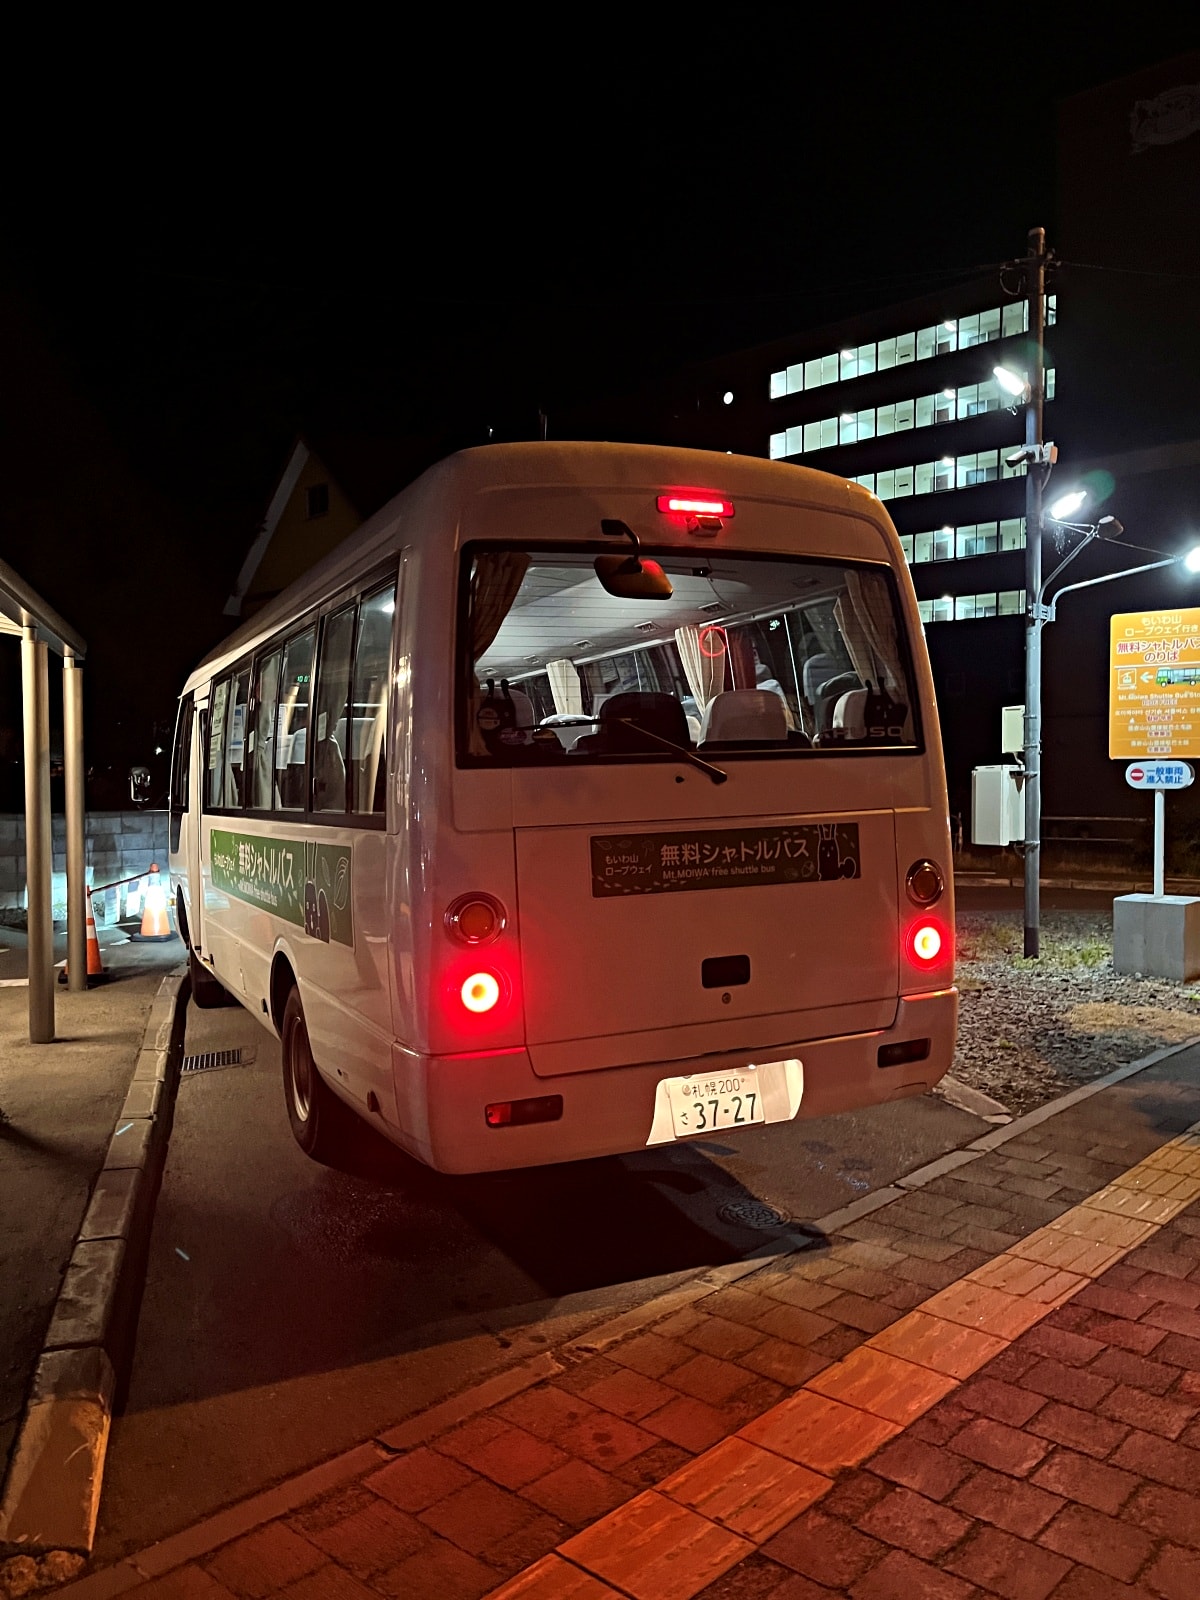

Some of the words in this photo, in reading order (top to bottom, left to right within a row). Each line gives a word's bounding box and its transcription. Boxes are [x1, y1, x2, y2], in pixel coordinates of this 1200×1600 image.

[1141, 615, 1182, 626] もいわ山
[1125, 624, 1199, 637] ロープウェイ行き
[1144, 650, 1179, 663] のりば
[833, 726, 903, 740] FUSO
[1146, 766, 1184, 776] 一般車両
[1146, 775, 1184, 785] 進入禁止
[661, 838, 809, 867] 無料シャトルバス
[239, 841, 294, 889] 無料シャトルバス
[605, 854, 639, 865] もいわ山
[605, 864, 653, 876] ロープウェイ
[663, 868, 709, 880] Mt.MOIWA
[711, 866, 729, 876] free
[731, 864, 759, 875] shuttle
[761, 864, 776, 873] bus
[680, 1111, 689, 1125] さ
[693, 1093, 757, 1130] 37-27
